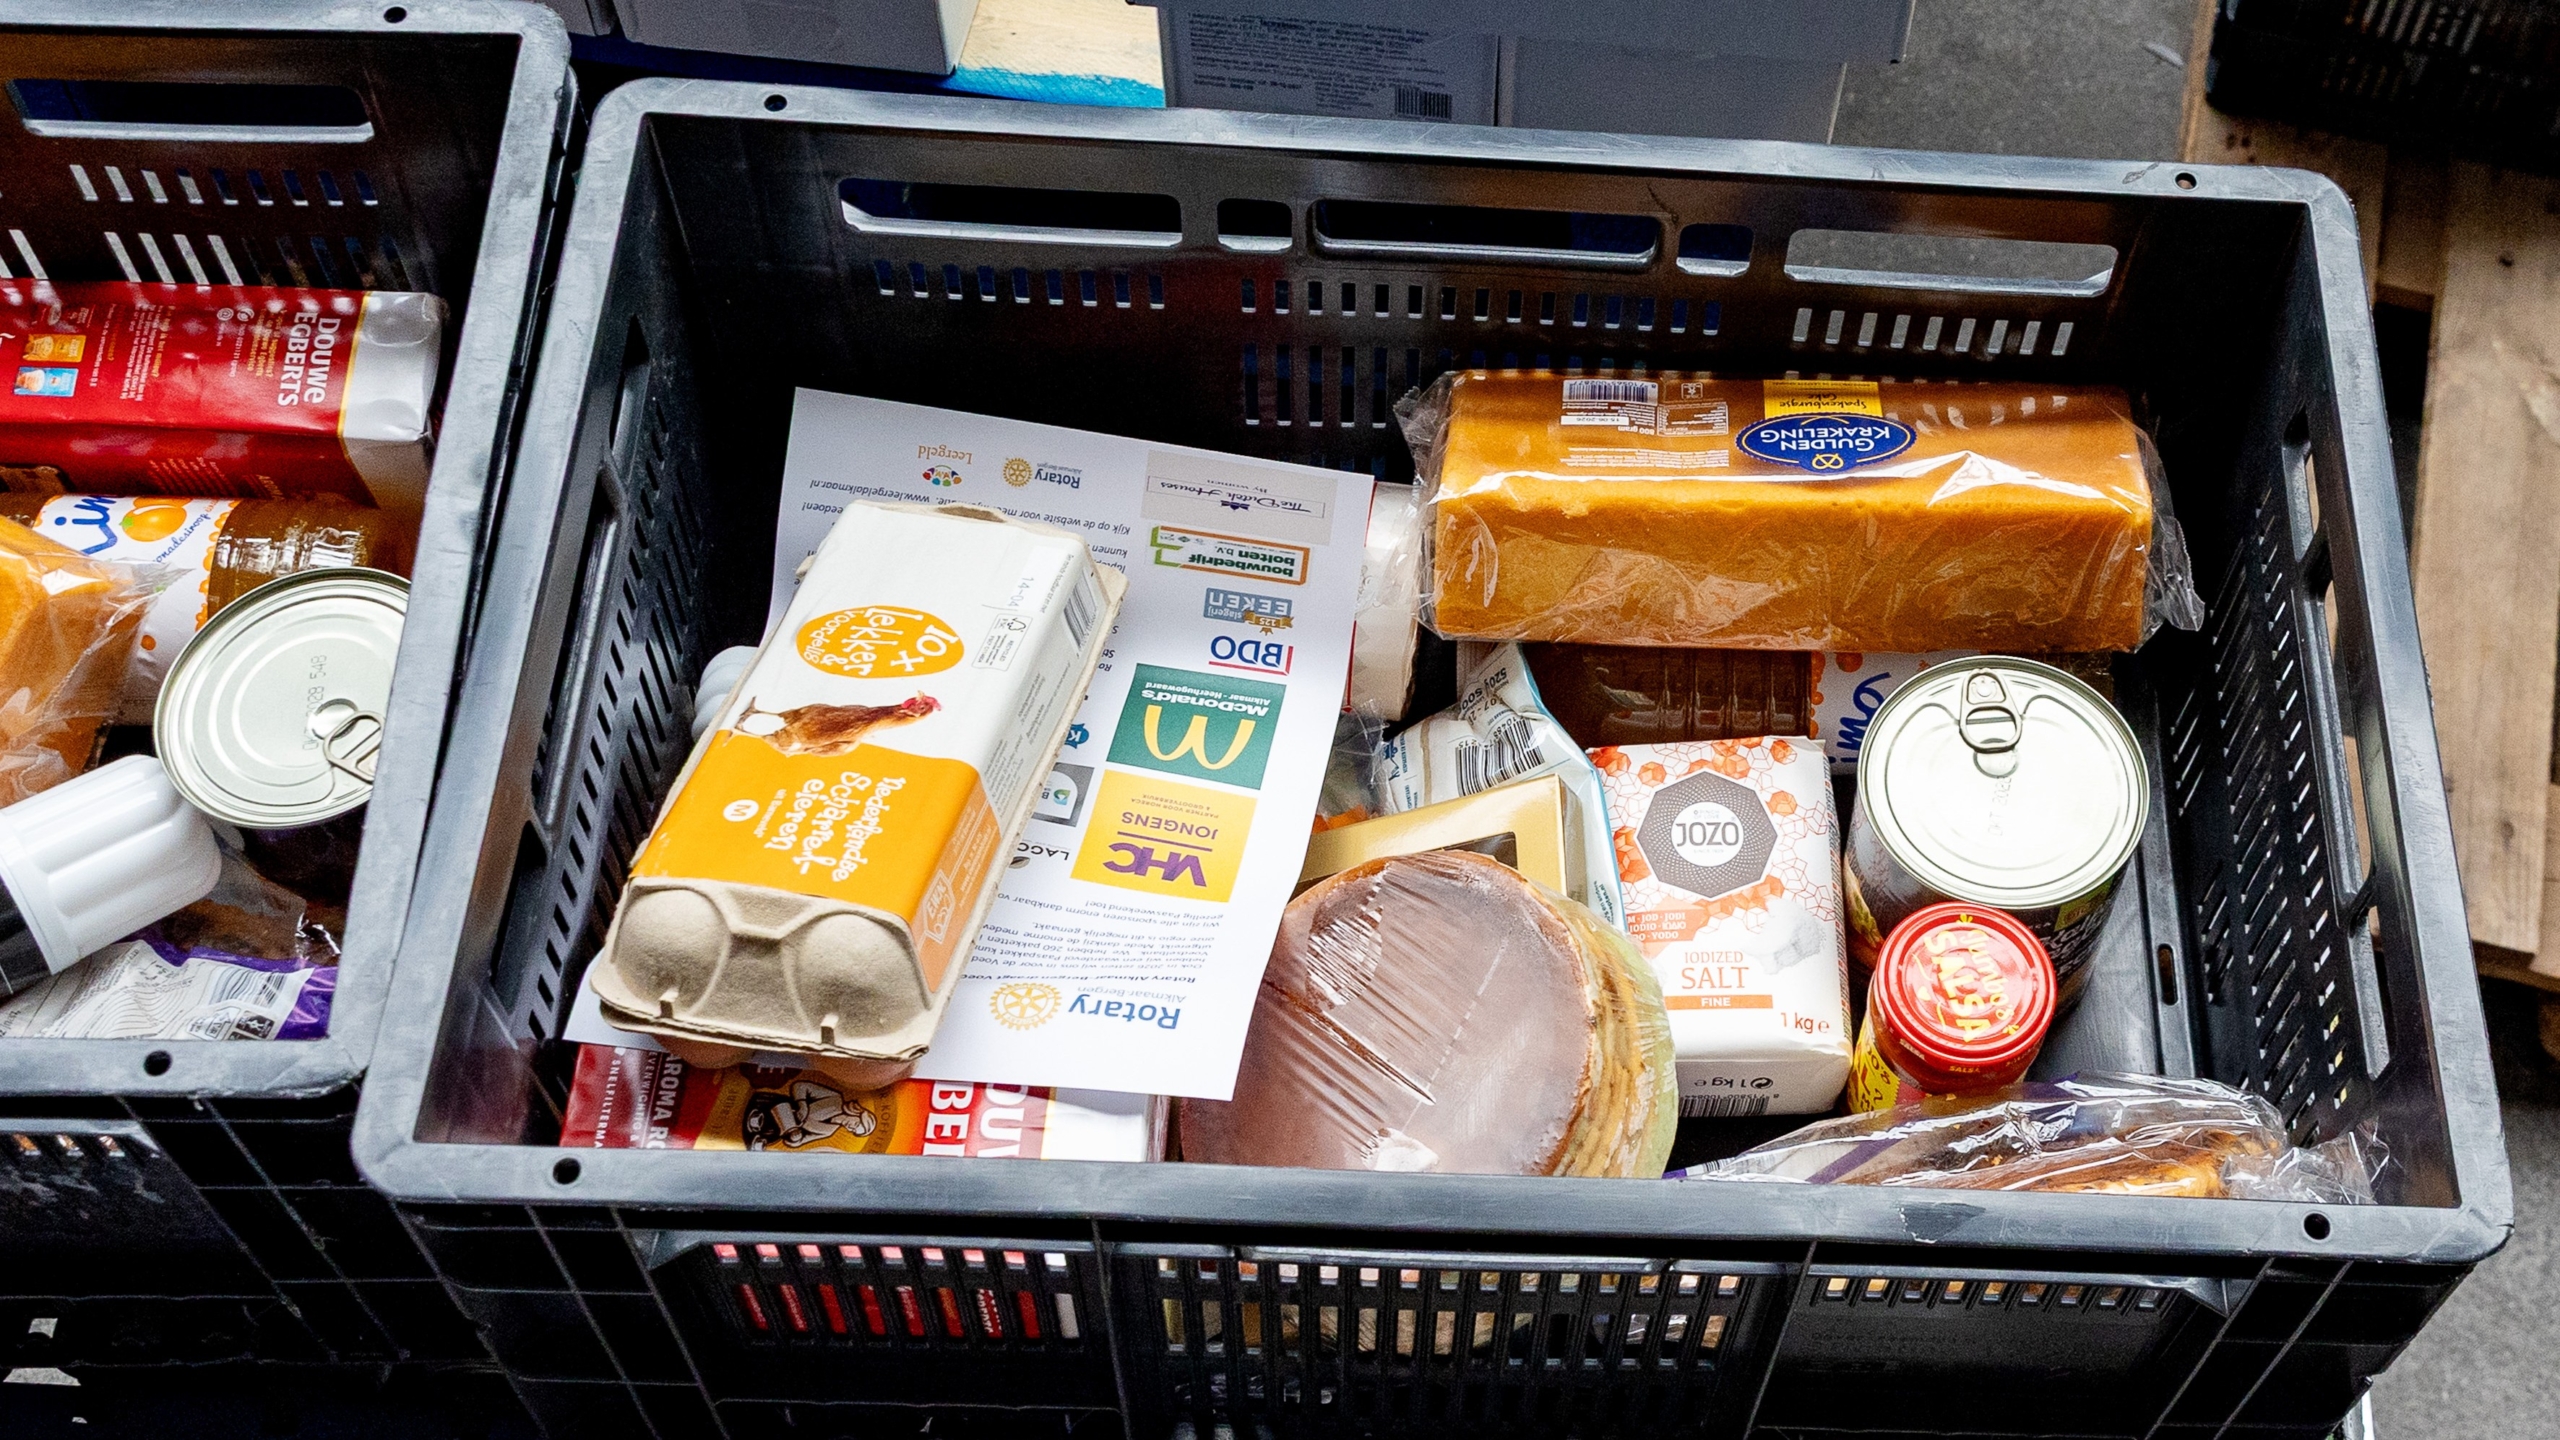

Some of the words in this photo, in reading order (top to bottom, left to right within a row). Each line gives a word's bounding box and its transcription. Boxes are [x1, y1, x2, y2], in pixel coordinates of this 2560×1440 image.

[277, 309, 317, 408] EGBERTS
[1778, 394, 1867, 412] Spakenburgse
[1806, 391, 1837, 401] Cake
[1759, 418, 1890, 449] KRAKELING
[1779, 433, 1875, 455] GULDEN
[917, 444, 972, 465] Leergeld
[1034, 467, 1079, 488] Rotary
[809, 478, 929, 503] www.leergeldalkmaar.nl
[1160, 481, 1222, 497] Houses
[801, 501, 843, 515] eedoen!
[1019, 509, 1040, 519] voor
[1044, 513, 1080, 526] website
[1082, 519, 1095, 529] de
[1097, 520, 1110, 530] op
[1112, 523, 1130, 535] Kijk
[1091, 543, 1127, 558] kunnen
[1188, 553, 1293, 577] bouwbedrijf
[1207, 605, 1241, 619] slagerij
[1259, 617, 1276, 626] 125
[803, 607, 865, 664] voordelig
[1210, 635, 1283, 667] BDO
[308, 654, 327, 680] 548
[820, 653, 848, 666] &
[1145, 681, 1222, 698] Heerhugowaard
[1141, 688, 1268, 715] McDonald's
[1228, 693, 1270, 705] Alkmaar
[764, 778, 826, 851] eieren
[1120, 810, 1218, 840] JONGENS
[1675, 820, 1739, 847] JOZO
[1101, 839, 1211, 887] VHC
[1012, 895, 1062, 911] dankbaar
[1065, 906, 1098, 916] enorm
[1103, 912, 1156, 923] sponsoren
[1639, 913, 1654, 922] JOD
[1664, 911, 1686, 920] JODI
[987, 935, 1040, 948] pakketten
[1023, 932, 1063, 941] enorme
[1082, 929, 1127, 940] mogelijk
[1083, 938, 1119, 947] dankzij
[1651, 931, 1679, 939] YODO
[999, 949, 1060, 960] Paaspakket
[1684, 950, 1744, 964] IODIZED
[1151, 975, 1195, 983] Rotary
[1680, 965, 1750, 990] SALT
[1077, 986, 1186, 1004] Alkmaar-Bergen
[1922, 931, 1990, 1044] SALSA
[1700, 996, 1731, 1007] FINE
[1068, 994, 1181, 1030] Rotary
[1780, 1011, 1788, 1028] 1
[1794, 1015, 1815, 1034] kg
[1711, 1075, 1735, 1091] kg
